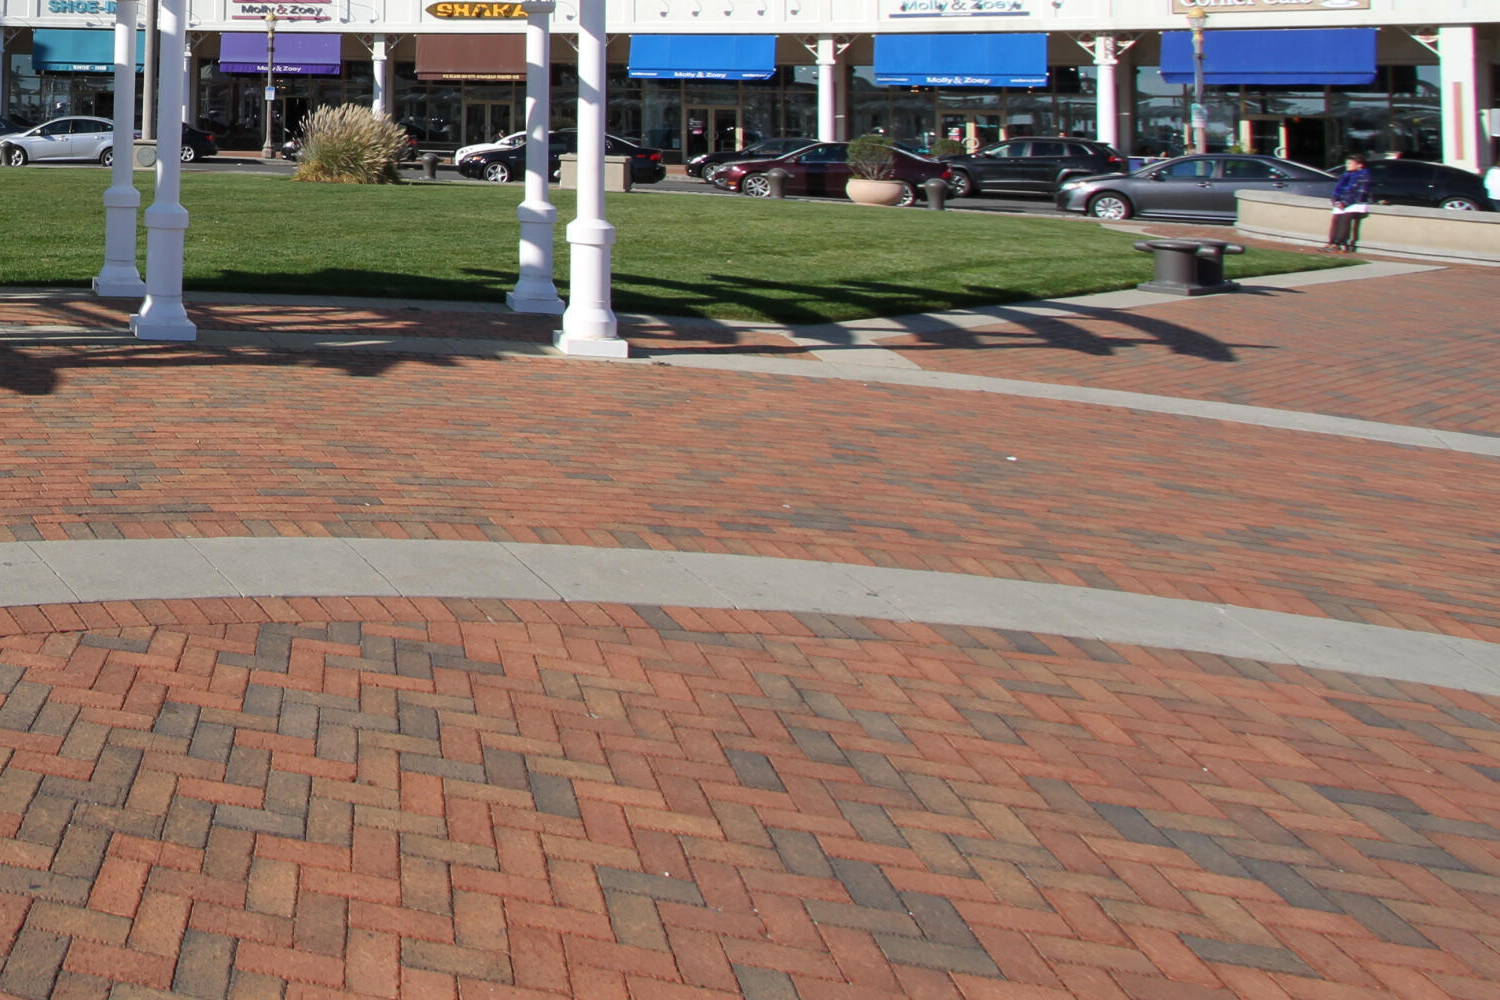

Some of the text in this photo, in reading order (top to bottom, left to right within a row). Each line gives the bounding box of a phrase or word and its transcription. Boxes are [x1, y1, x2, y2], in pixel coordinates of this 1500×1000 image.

[48, 0, 117, 14] SHOE-IN
[241, 4, 323, 16] Molly & Zoey
[436, 3, 529, 17] SHAKA
[901, 0, 949, 12] Molly
[970, 0, 1022, 12] Zoey
[926, 76, 991, 85] Molly & Zoey
